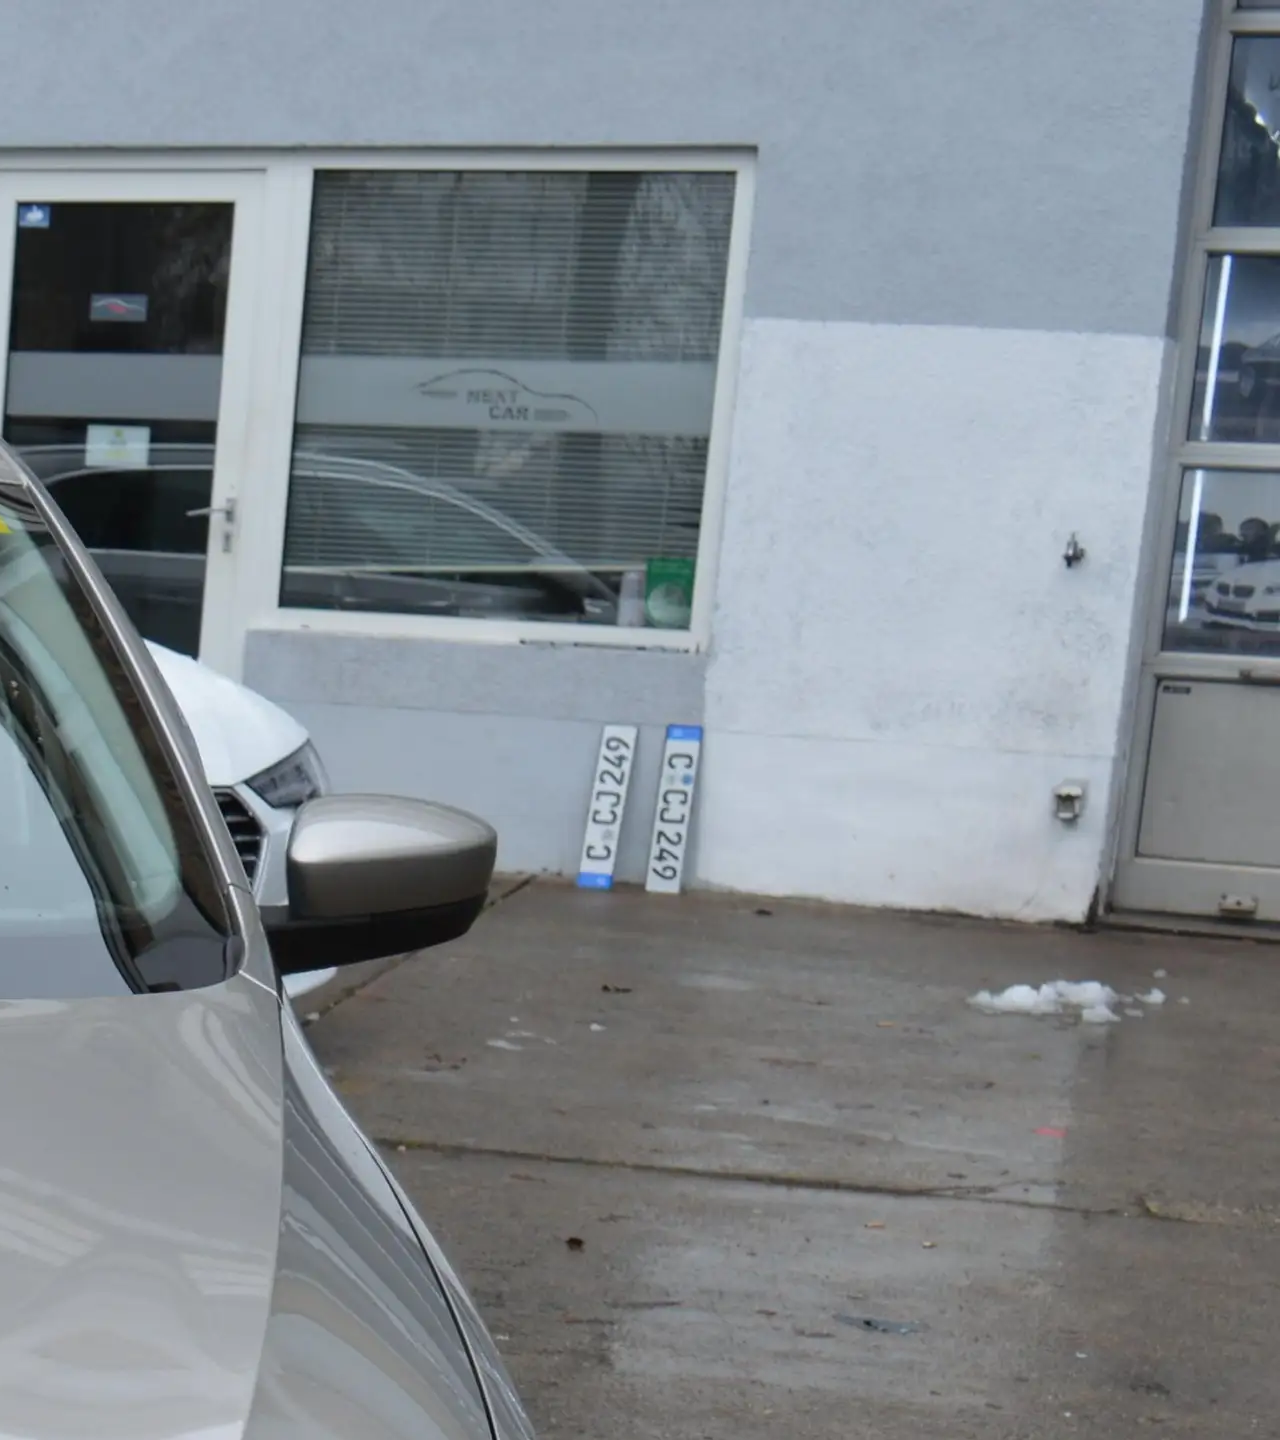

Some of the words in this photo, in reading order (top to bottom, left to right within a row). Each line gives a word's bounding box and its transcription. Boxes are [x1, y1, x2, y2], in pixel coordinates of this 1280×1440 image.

[489, 406, 530, 421] CAR
[668, 753, 694, 770] C
[586, 844, 612, 861] C
